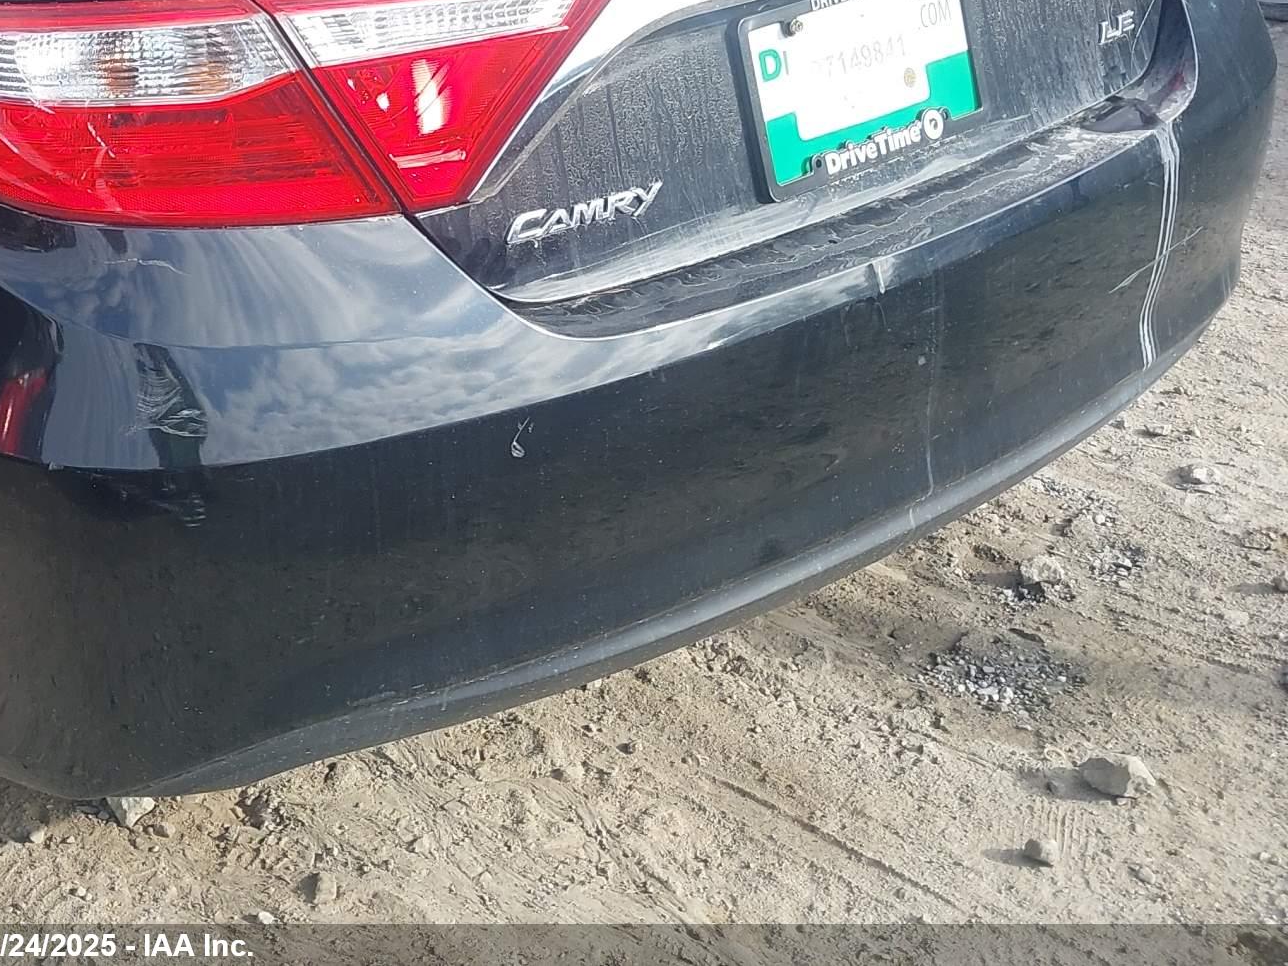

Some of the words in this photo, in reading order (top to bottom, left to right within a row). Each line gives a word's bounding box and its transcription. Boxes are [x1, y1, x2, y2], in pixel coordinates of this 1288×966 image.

[1098, 9, 1136, 46] LE
[824, 119, 922, 175] DriveTime
[507, 181, 663, 244] CAMRY
